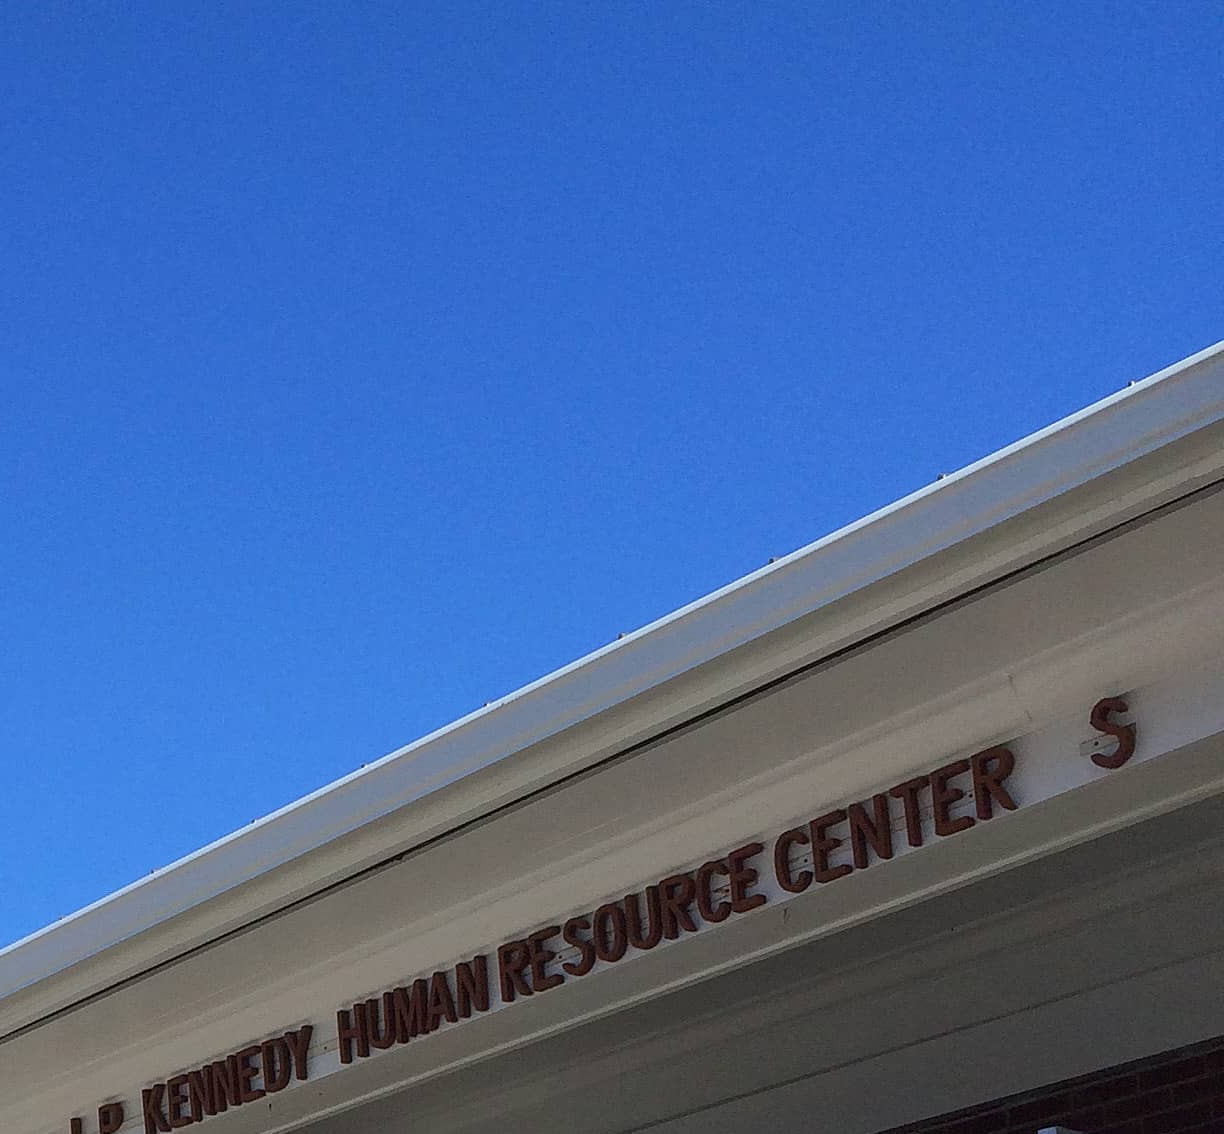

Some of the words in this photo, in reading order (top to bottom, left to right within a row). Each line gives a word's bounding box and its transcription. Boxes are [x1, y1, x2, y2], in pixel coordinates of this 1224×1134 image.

[337, 954, 490, 1064] HUMAN
[498, 842, 767, 1002] RESOURCE
[775, 746, 1019, 894] CENTER
[1090, 697, 1137, 769] S
